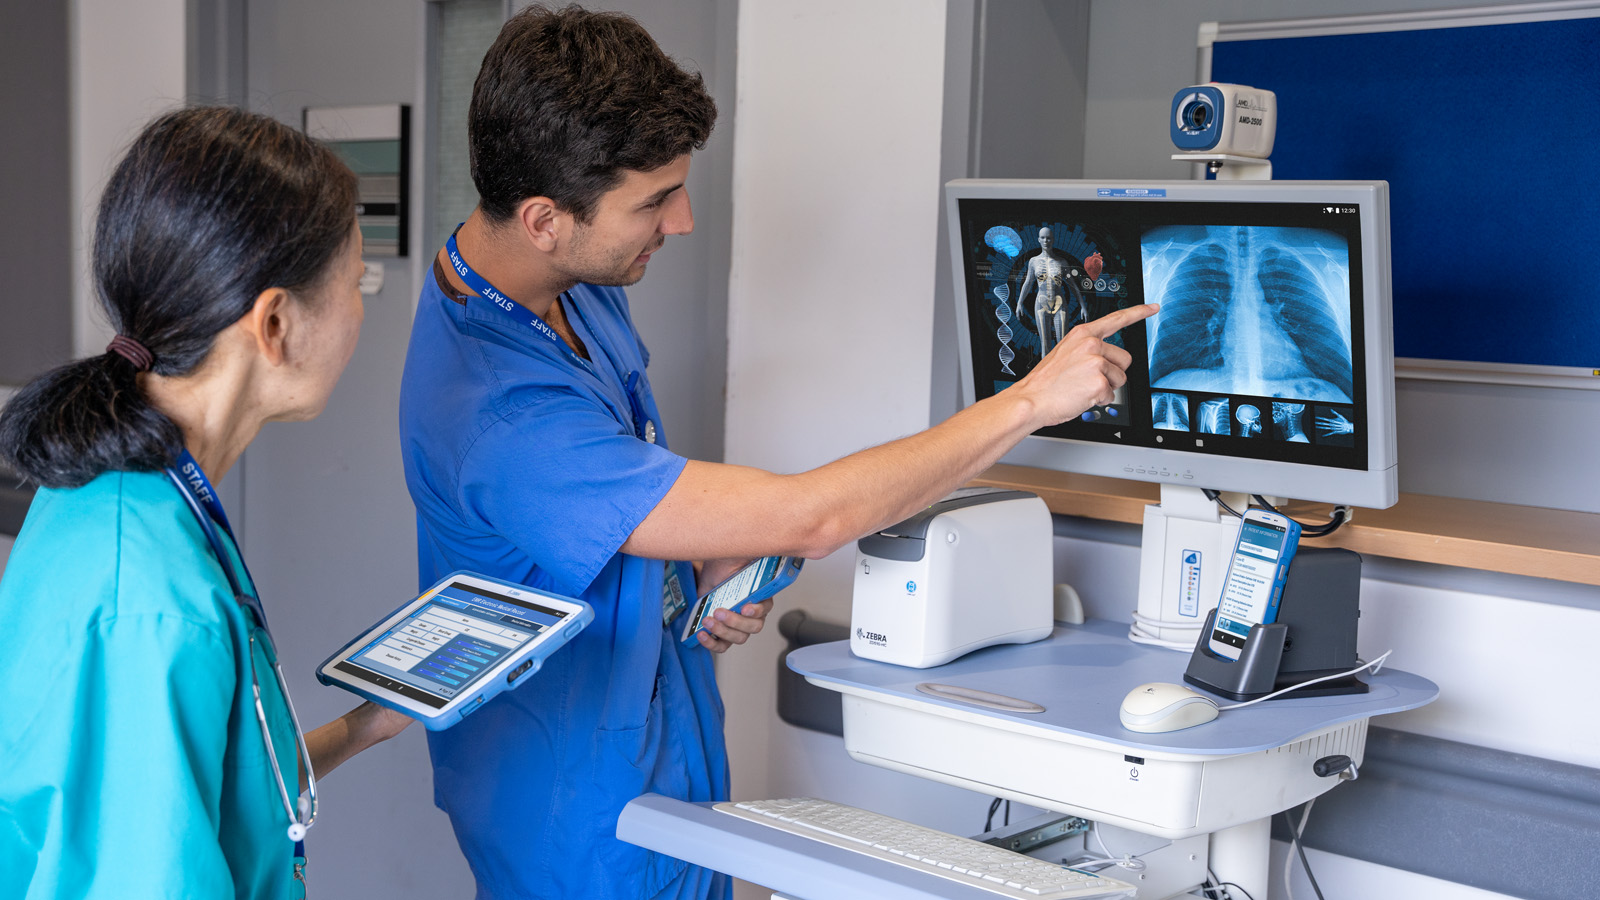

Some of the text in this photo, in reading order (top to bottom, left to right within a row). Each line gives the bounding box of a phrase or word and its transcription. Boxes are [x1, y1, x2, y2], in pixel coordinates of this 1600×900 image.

[1238, 115, 1263, 126] AMD-2500
[450, 251, 468, 277] STAFF
[482, 287, 514, 312] STAFF
[530, 318, 557, 341] STAFF
[182, 462, 214, 503] STAFF
[866, 631, 887, 642] ZEBRA
